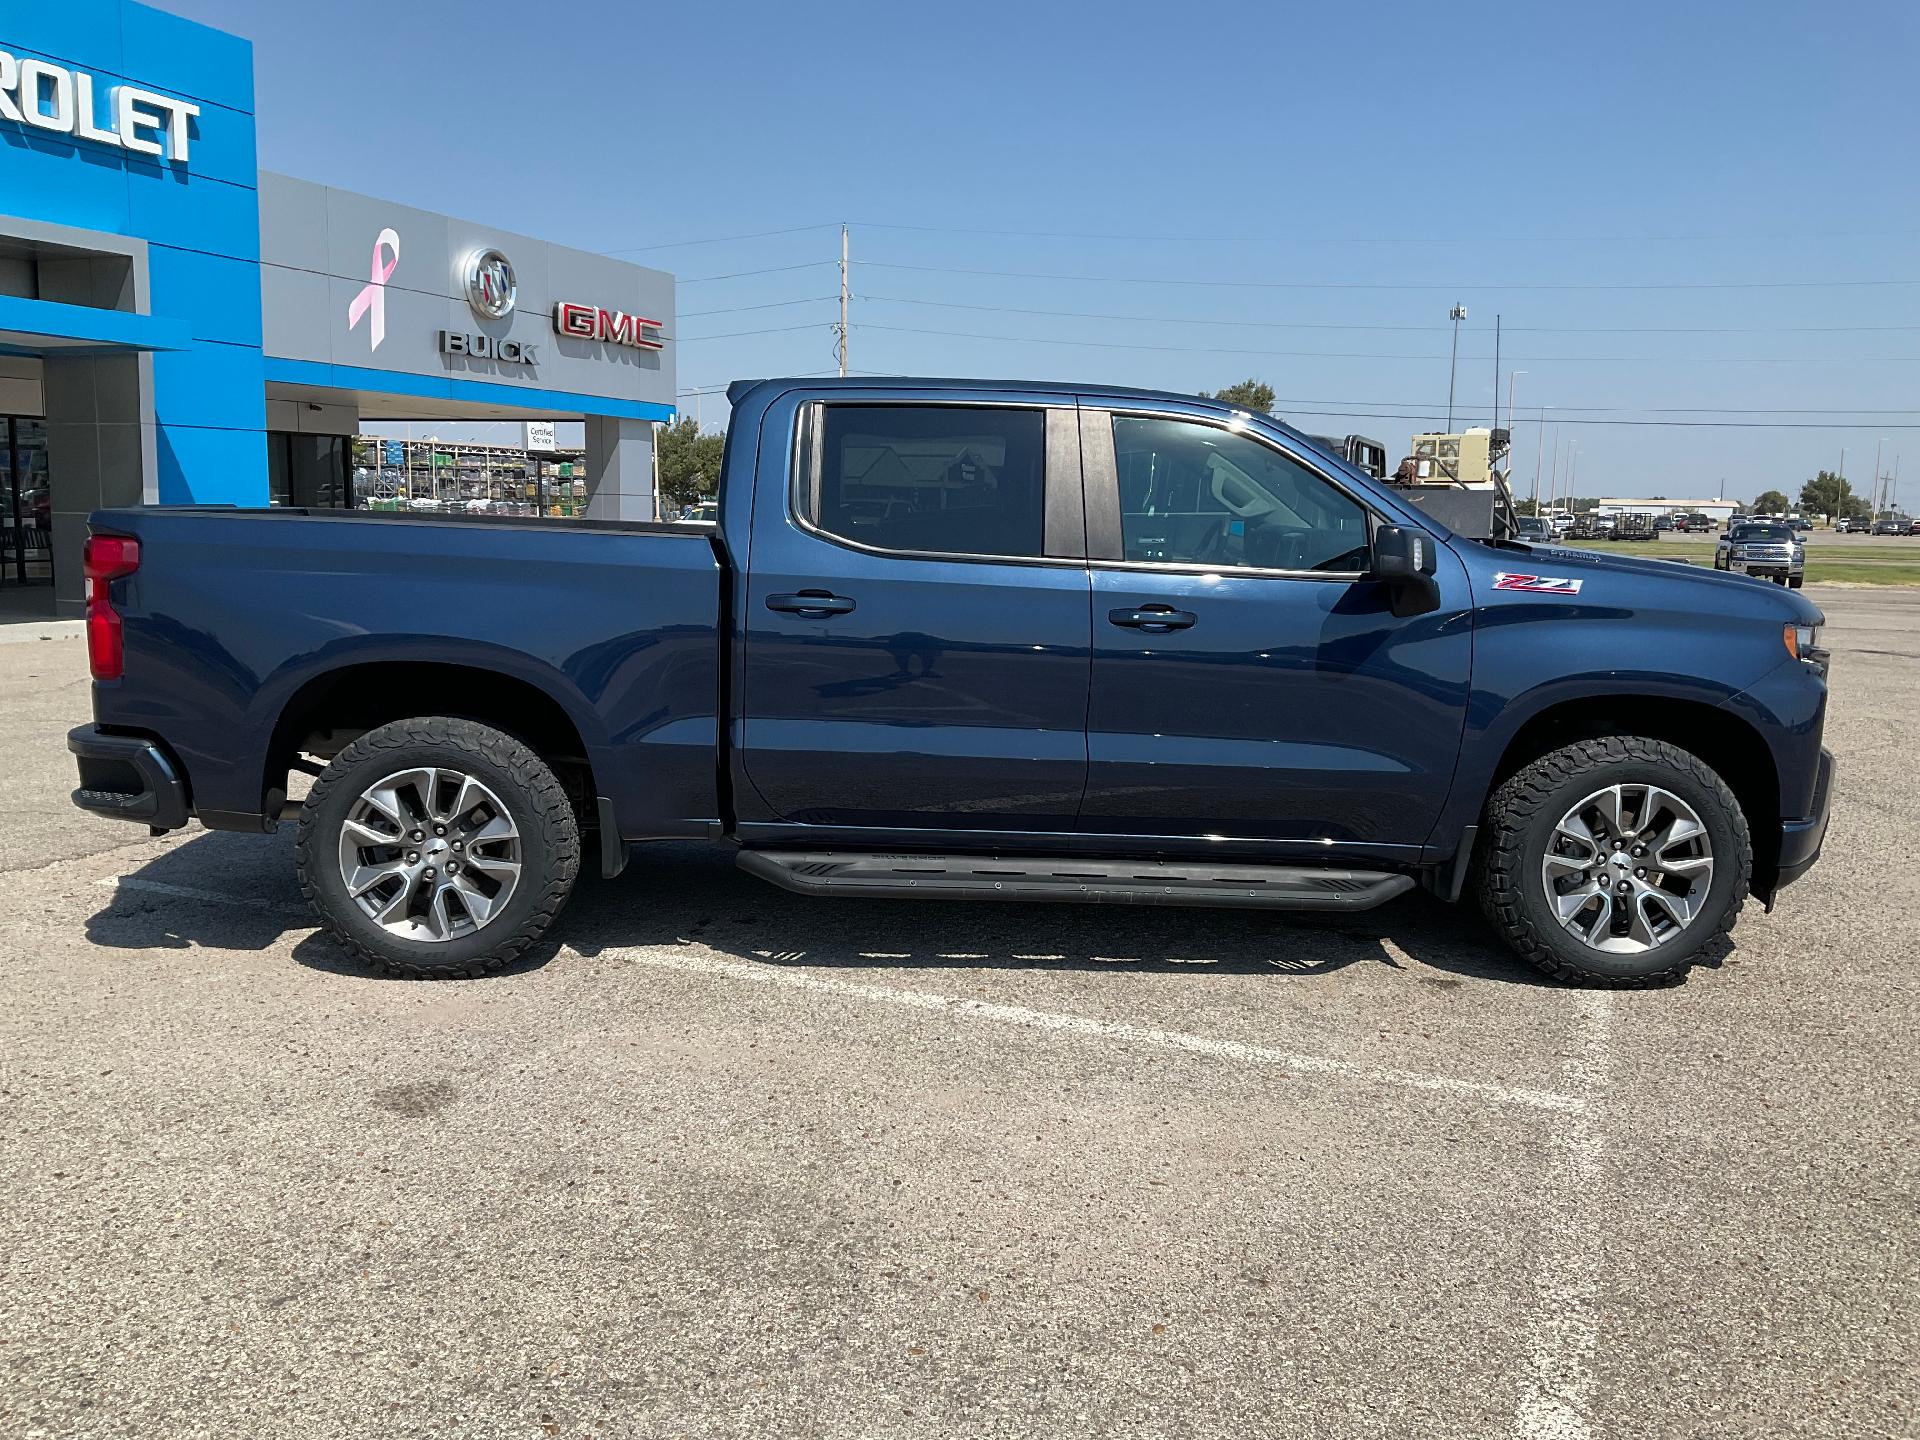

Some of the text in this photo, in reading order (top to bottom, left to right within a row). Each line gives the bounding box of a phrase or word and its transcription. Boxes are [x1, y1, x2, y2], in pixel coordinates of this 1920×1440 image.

[555, 301, 664, 350] GMC
[442, 331, 540, 365] BUICK
[530, 427, 553, 436] Certified
[532, 436, 552, 444] Service
